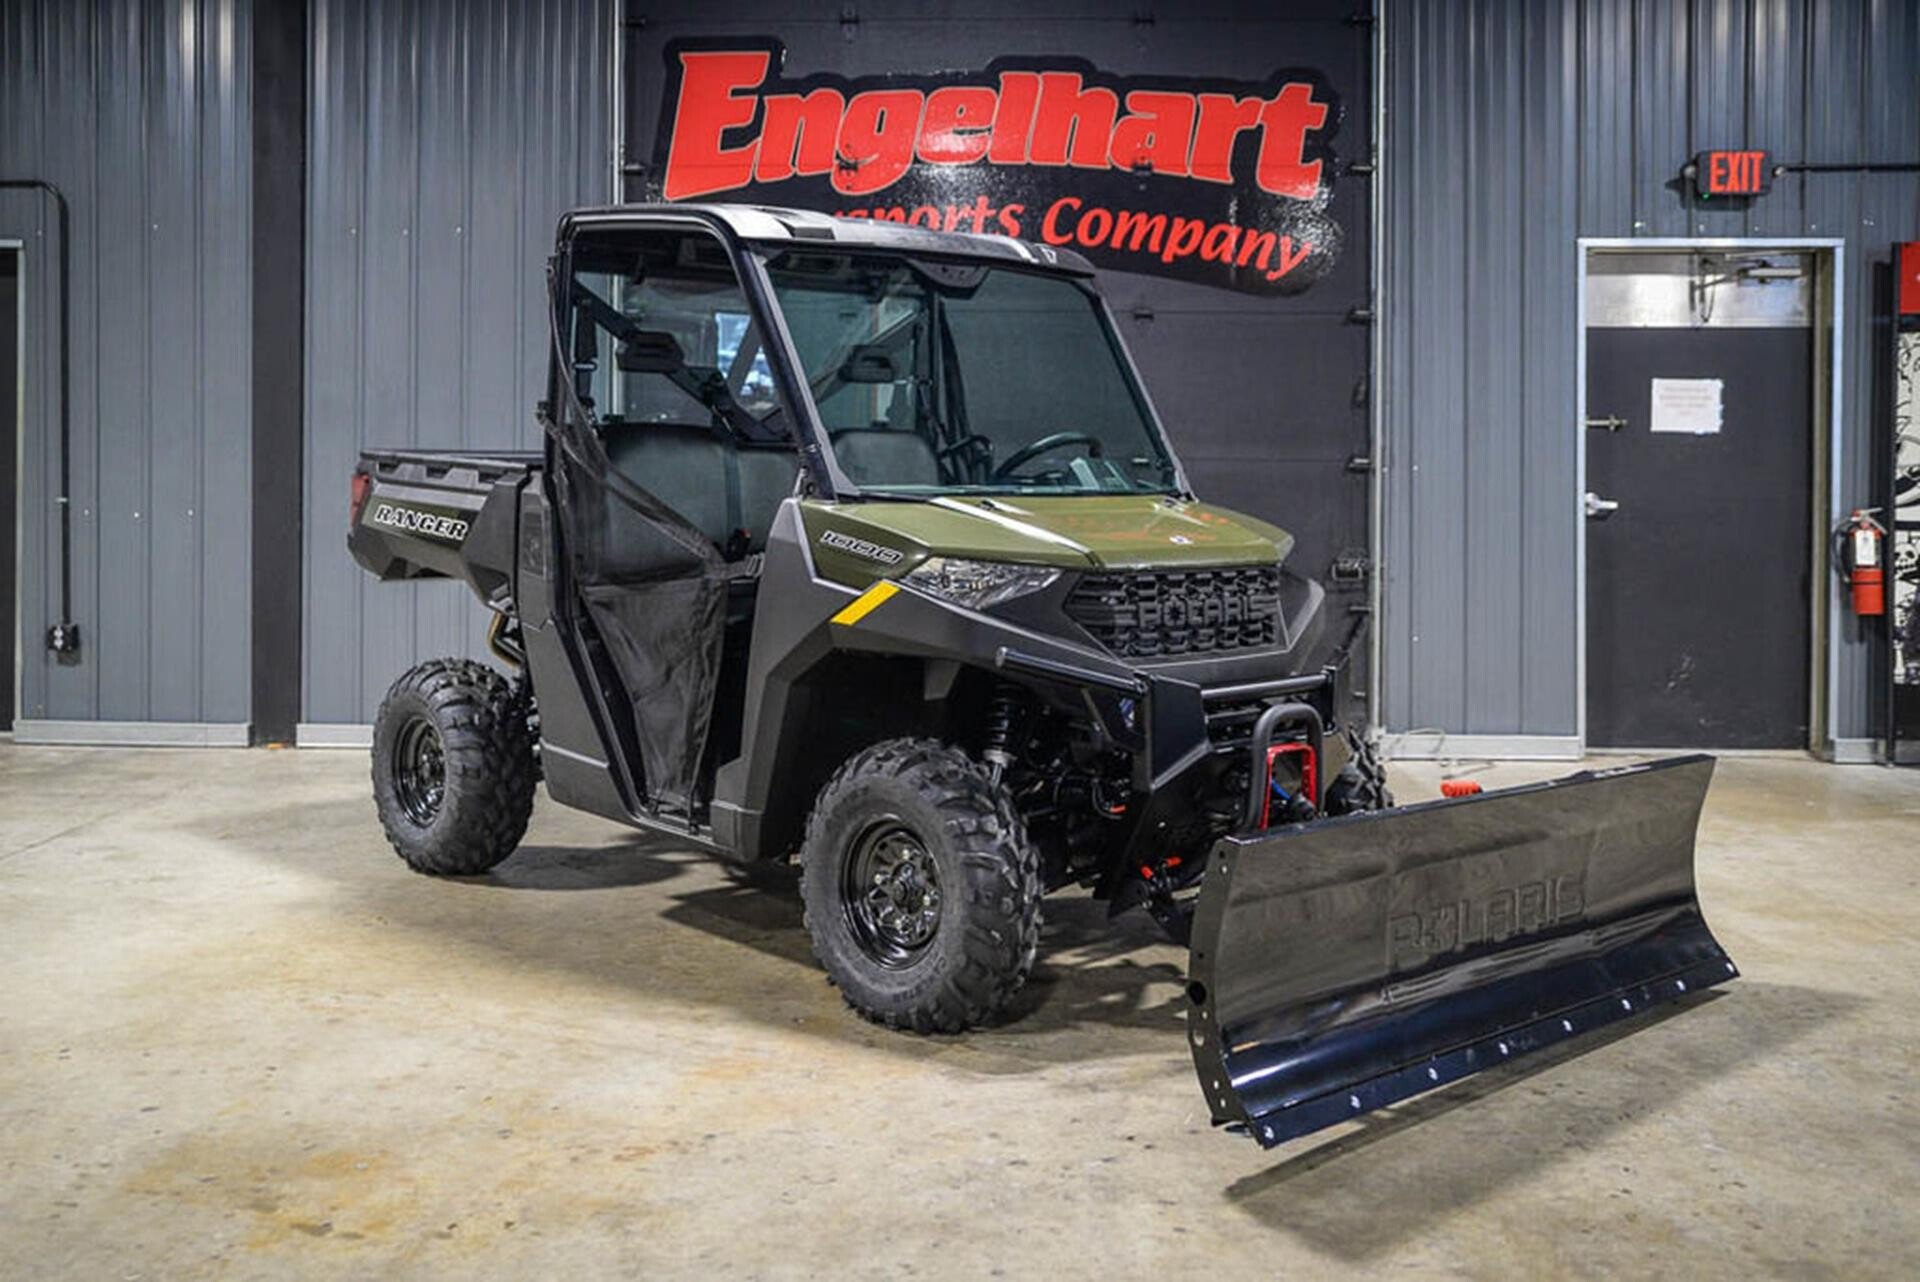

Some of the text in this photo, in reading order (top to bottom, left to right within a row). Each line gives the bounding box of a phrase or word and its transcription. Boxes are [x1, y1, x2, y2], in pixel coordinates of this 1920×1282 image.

[664, 50, 1329, 199] Engelhart
[1709, 151, 1765, 193] EXIT
[1041, 197, 1312, 281] Company
[374, 504, 468, 540] RANGER
[1385, 875, 1585, 976] POLARIS
